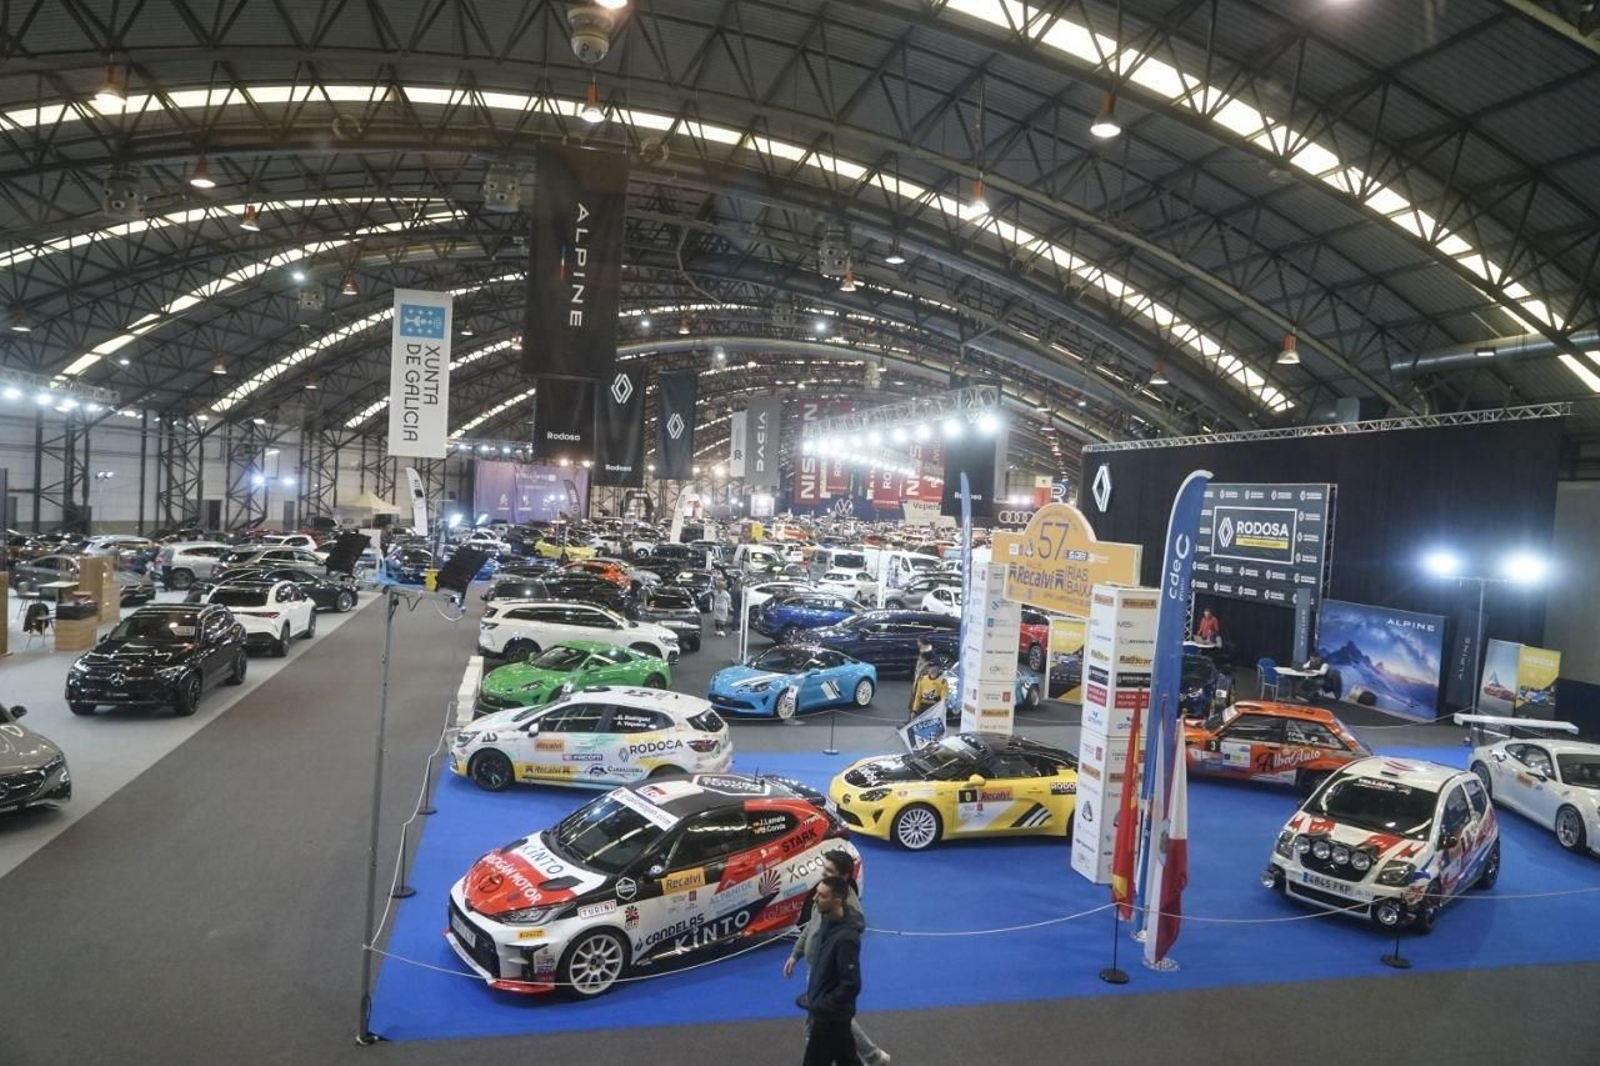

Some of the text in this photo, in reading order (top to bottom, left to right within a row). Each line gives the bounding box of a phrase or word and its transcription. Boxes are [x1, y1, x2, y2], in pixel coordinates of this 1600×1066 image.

[569, 202, 590, 328] ALPINE
[424, 344, 441, 406] XUNTA
[402, 343, 421, 442] DE GALICIA
[547, 431, 581, 441] Rodosa
[800, 403, 818, 500] NISSN
[605, 463, 632, 472] Rodosa
[954, 491, 982, 500] Roosa
[1236, 520, 1290, 537] RODOSA
[1039, 521, 1069, 560] 57
[1017, 565, 1055, 590] Recalvi
[1387, 618, 1436, 632] ALPINE
[1458, 637, 1471, 680] ALPINE
[629, 739, 684, 756] RODOCA
[1211, 742, 1216, 750] 3
[1050, 782, 1077, 791] RODO
[782, 827, 818, 853] STARK
[666, 876, 701, 889] Recalvi
[645, 912, 705, 946] CANDELAS
